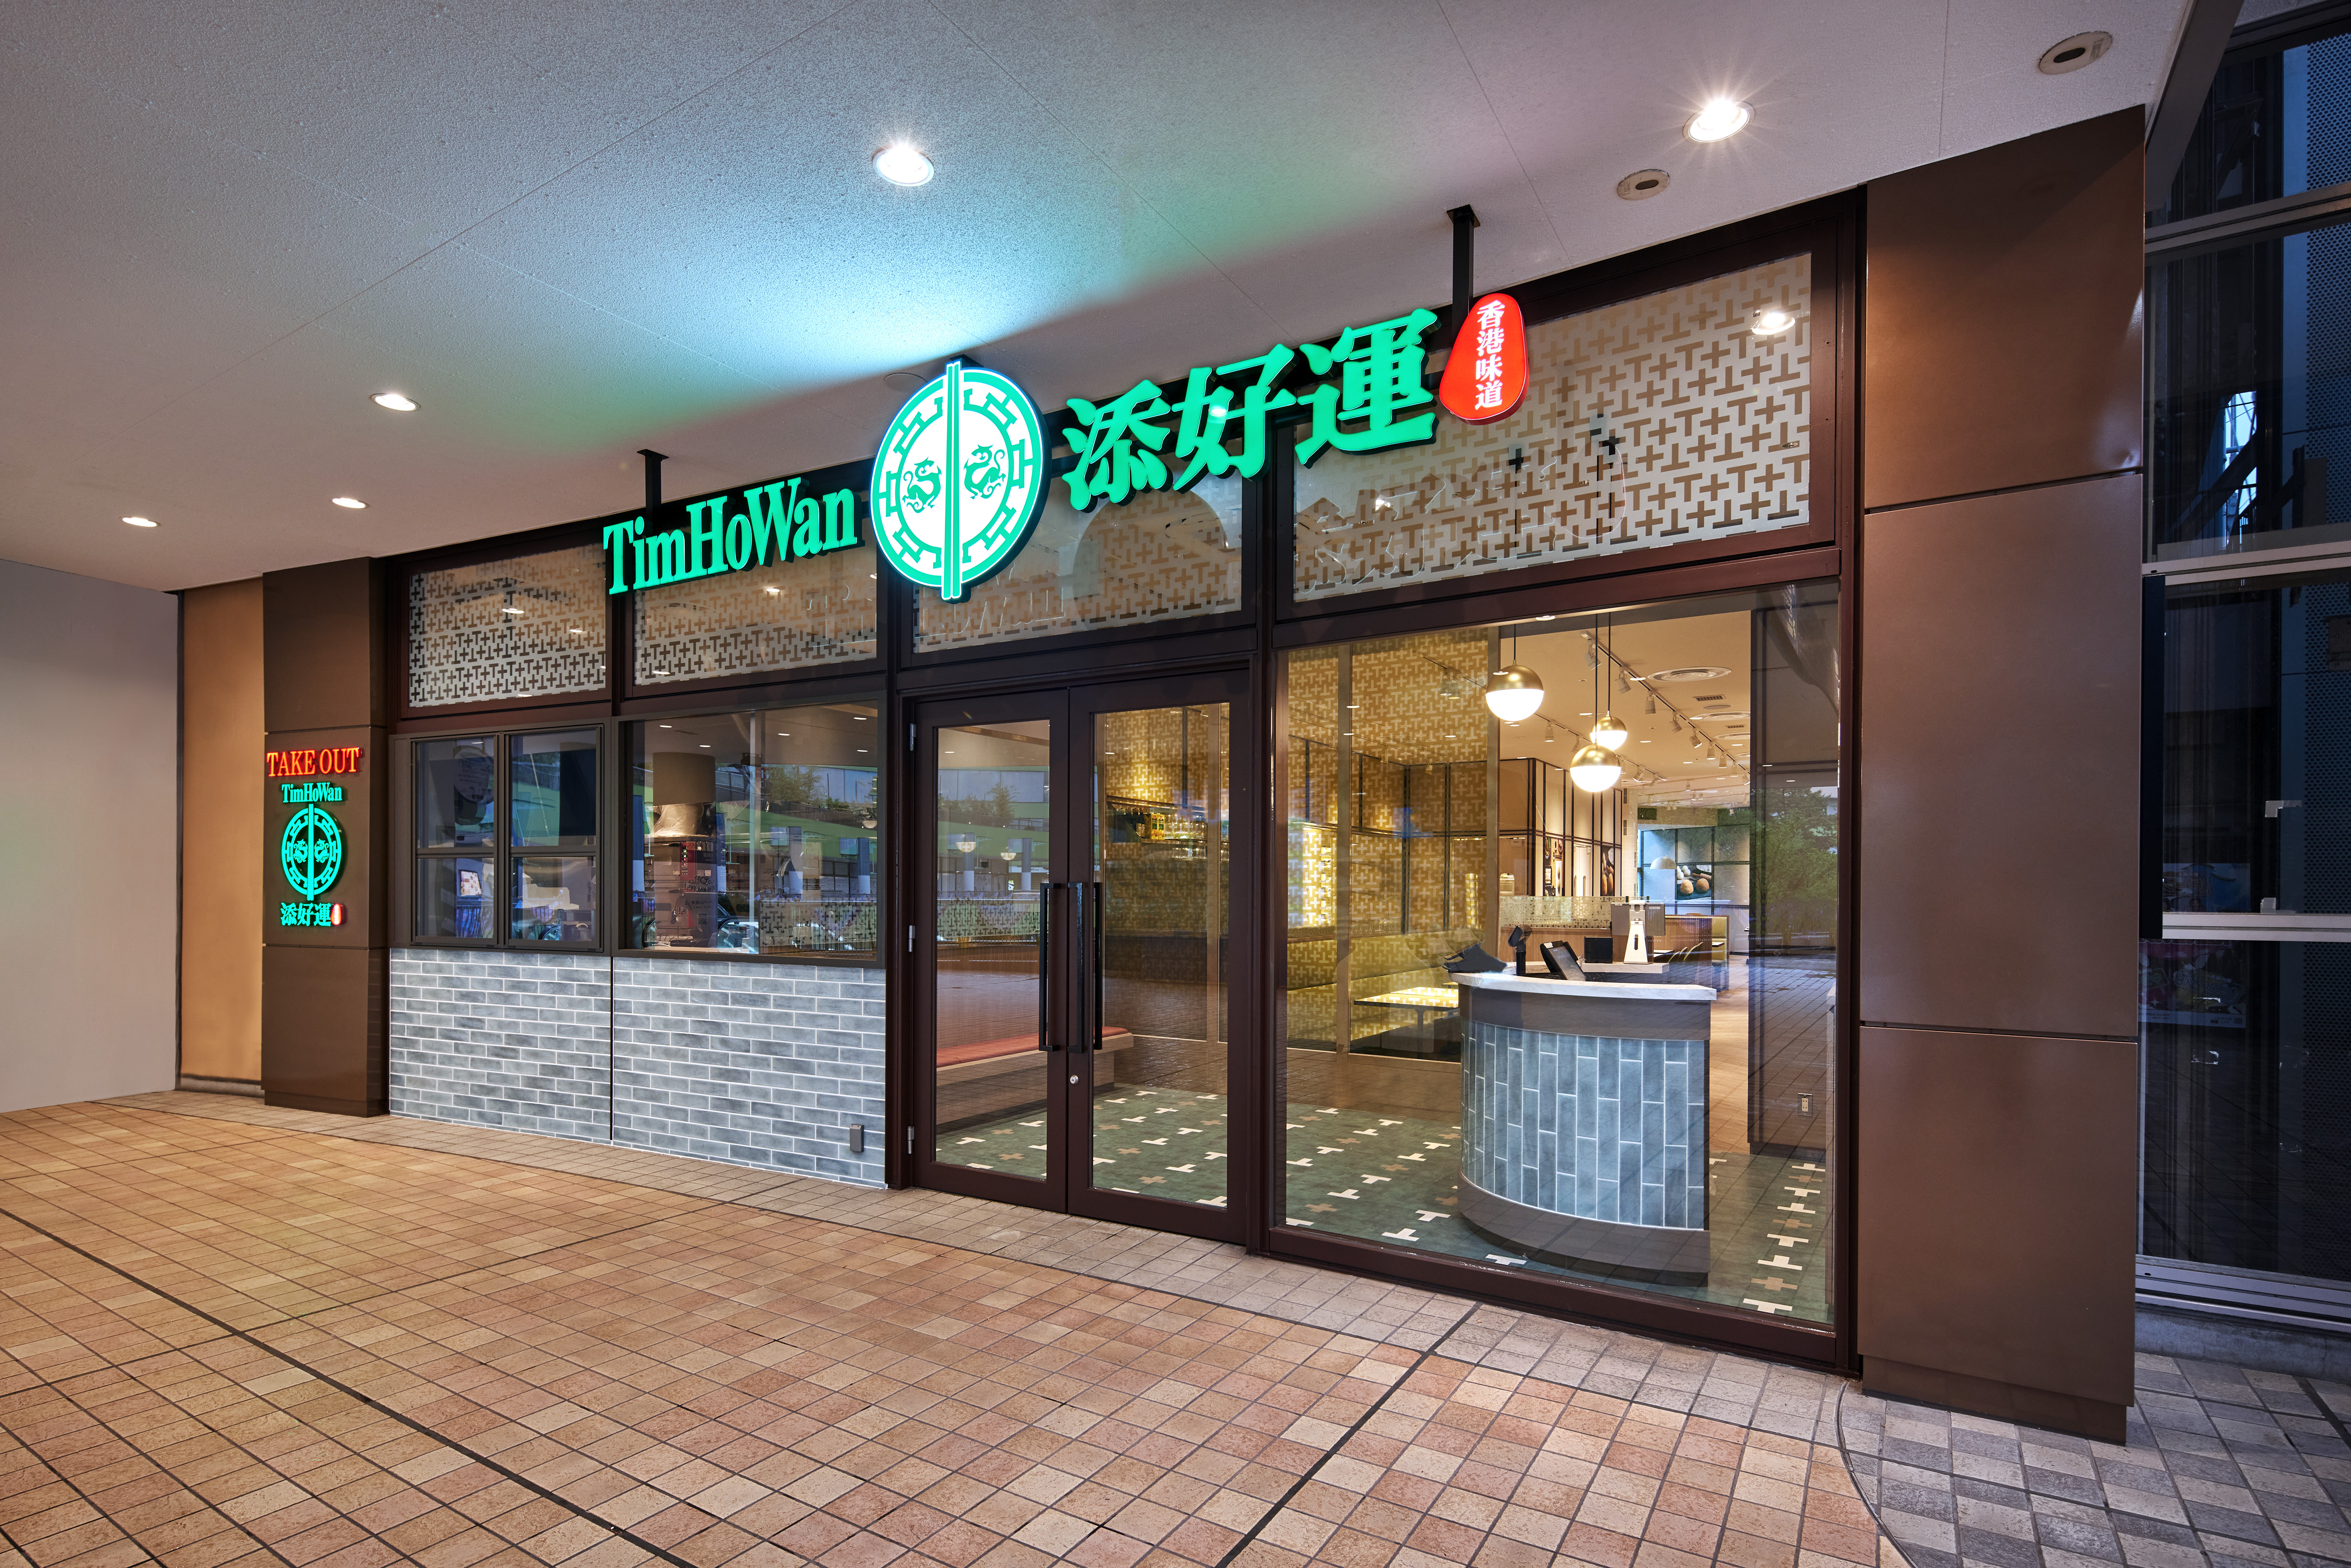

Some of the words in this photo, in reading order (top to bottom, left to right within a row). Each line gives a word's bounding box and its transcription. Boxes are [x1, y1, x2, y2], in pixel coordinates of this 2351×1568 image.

[1474, 300, 1505, 410] 香港味道
[1062, 308, 1438, 510] 添好運
[603, 477, 857, 595] TimHoWan
[267, 750, 315, 776] TAKE
[319, 747, 359, 775] OUT
[282, 782, 342, 803] TimHoWan
[280, 902, 331, 926] 添好運
